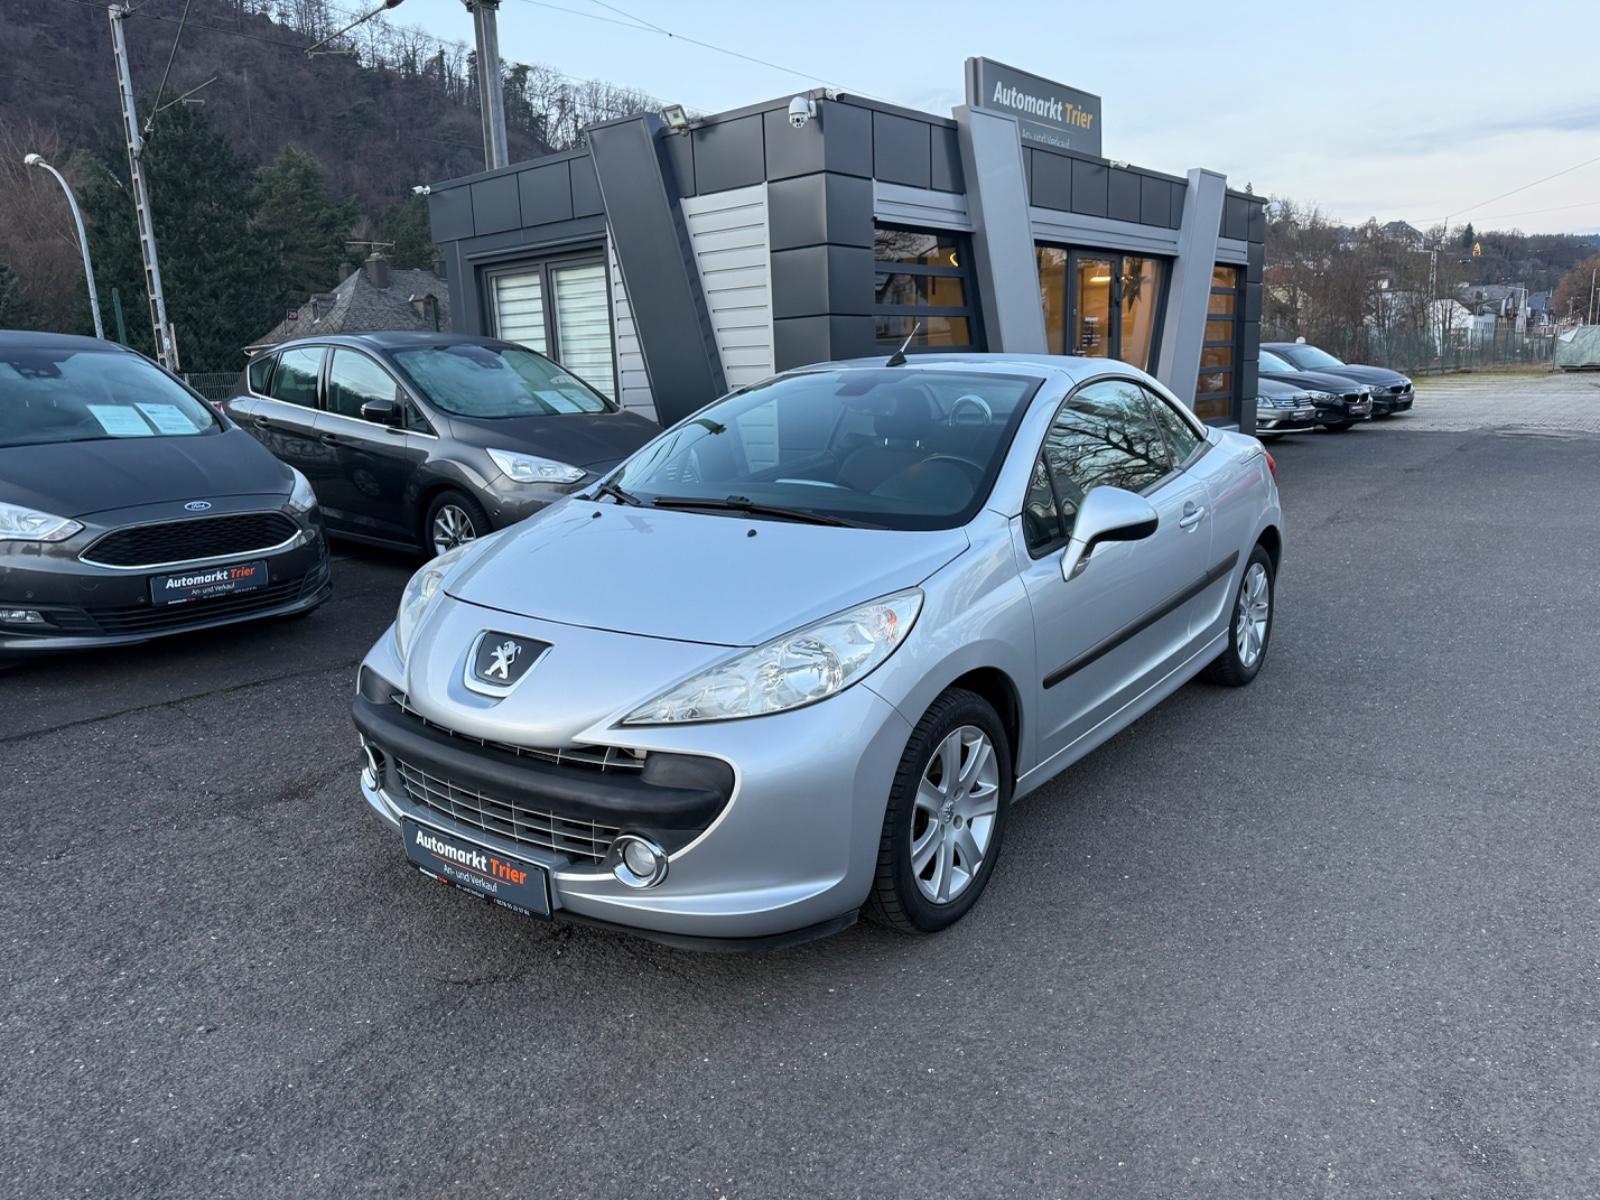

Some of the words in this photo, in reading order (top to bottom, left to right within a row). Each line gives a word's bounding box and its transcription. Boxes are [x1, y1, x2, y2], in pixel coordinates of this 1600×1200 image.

[993, 80, 1063, 121] Automarkt
[1065, 102, 1093, 129] Trier
[165, 570, 228, 589] Automarkt
[230, 567, 256, 578] Trier
[202, 585, 214, 593] und
[214, 581, 235, 592] Verkauf
[416, 830, 487, 872] Automarkt
[490, 858, 527, 885] Trier
[443, 864, 455, 875] An-
[455, 870, 470, 882] und
[471, 874, 498, 893] Verkauf
